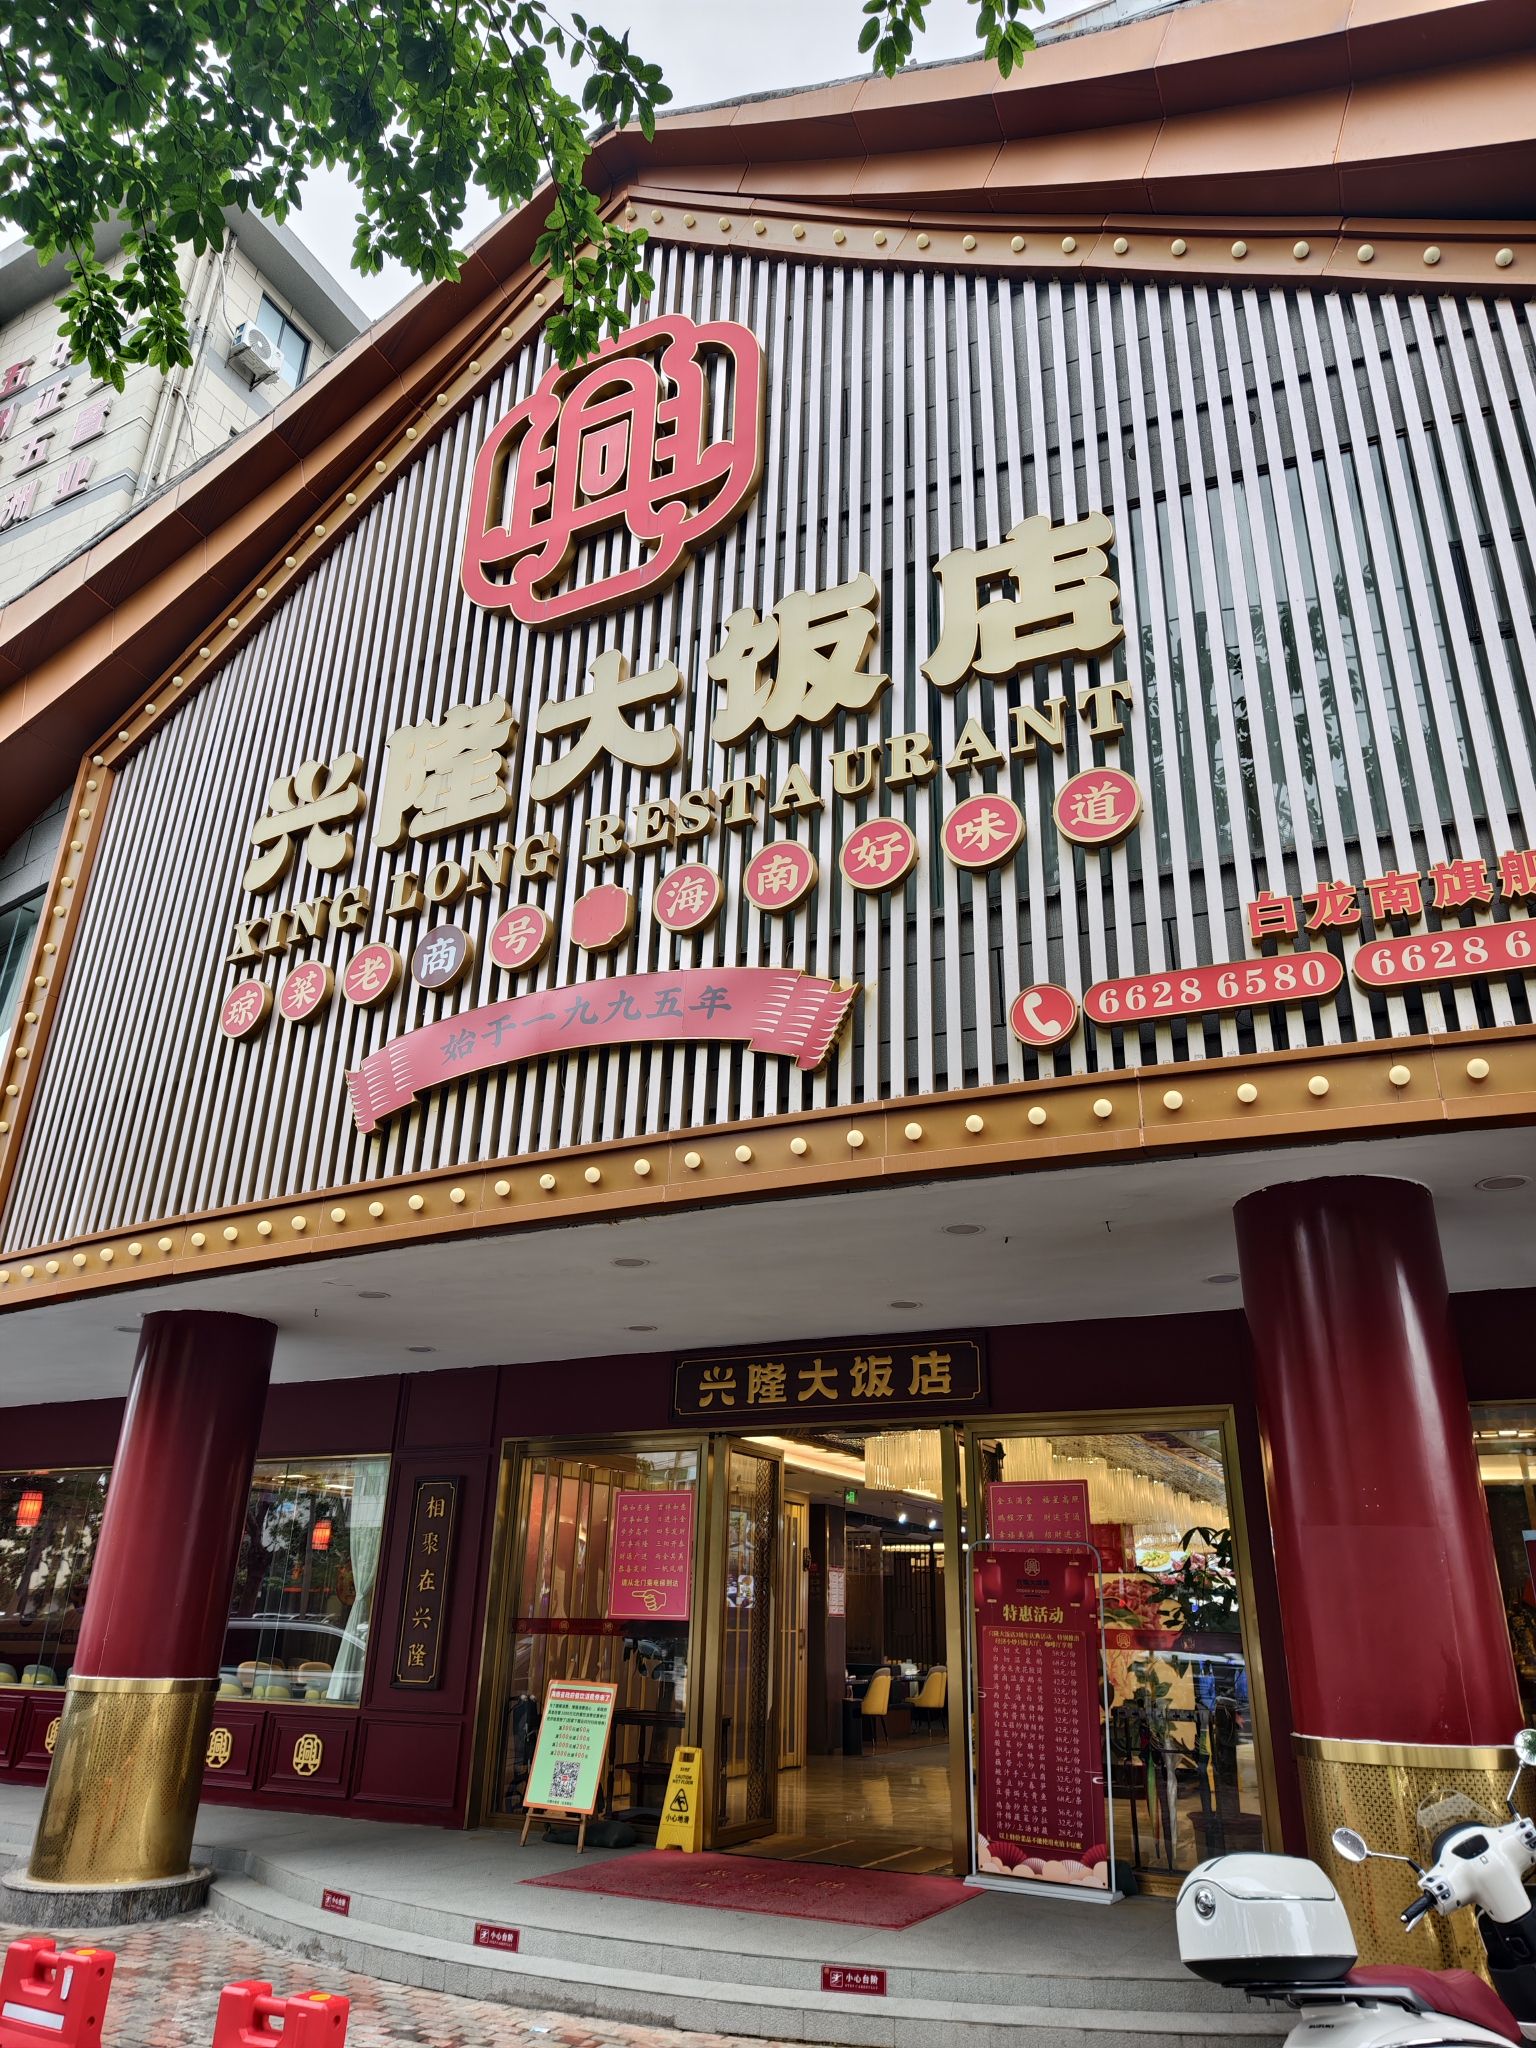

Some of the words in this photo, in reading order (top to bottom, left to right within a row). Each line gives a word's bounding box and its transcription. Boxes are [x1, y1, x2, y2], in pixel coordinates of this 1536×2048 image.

[243, 511, 1125, 894] 兴隆大饭店
[227, 885, 370, 964] XING
[386, 832, 560, 919] LONG
[582, 681, 1133, 865] RESTAURANT
[666, 781, 1125, 915] 海南好味道
[1371, 936, 1489, 977] 6628
[1099, 977, 1202, 1014] 6628
[1217, 960, 1326, 999] 6580
[440, 985, 732, 1064] 始于一九九五年
[699, 1351, 952, 1407] 兴隆大饭店
[407, 1496, 446, 1667] 相聚在兴隆
[1003, 1603, 1064, 1624] 特惠活动
[665, 1815, 690, 1825] 小心地滑
[845, 1972, 878, 1984] 小心台阶
